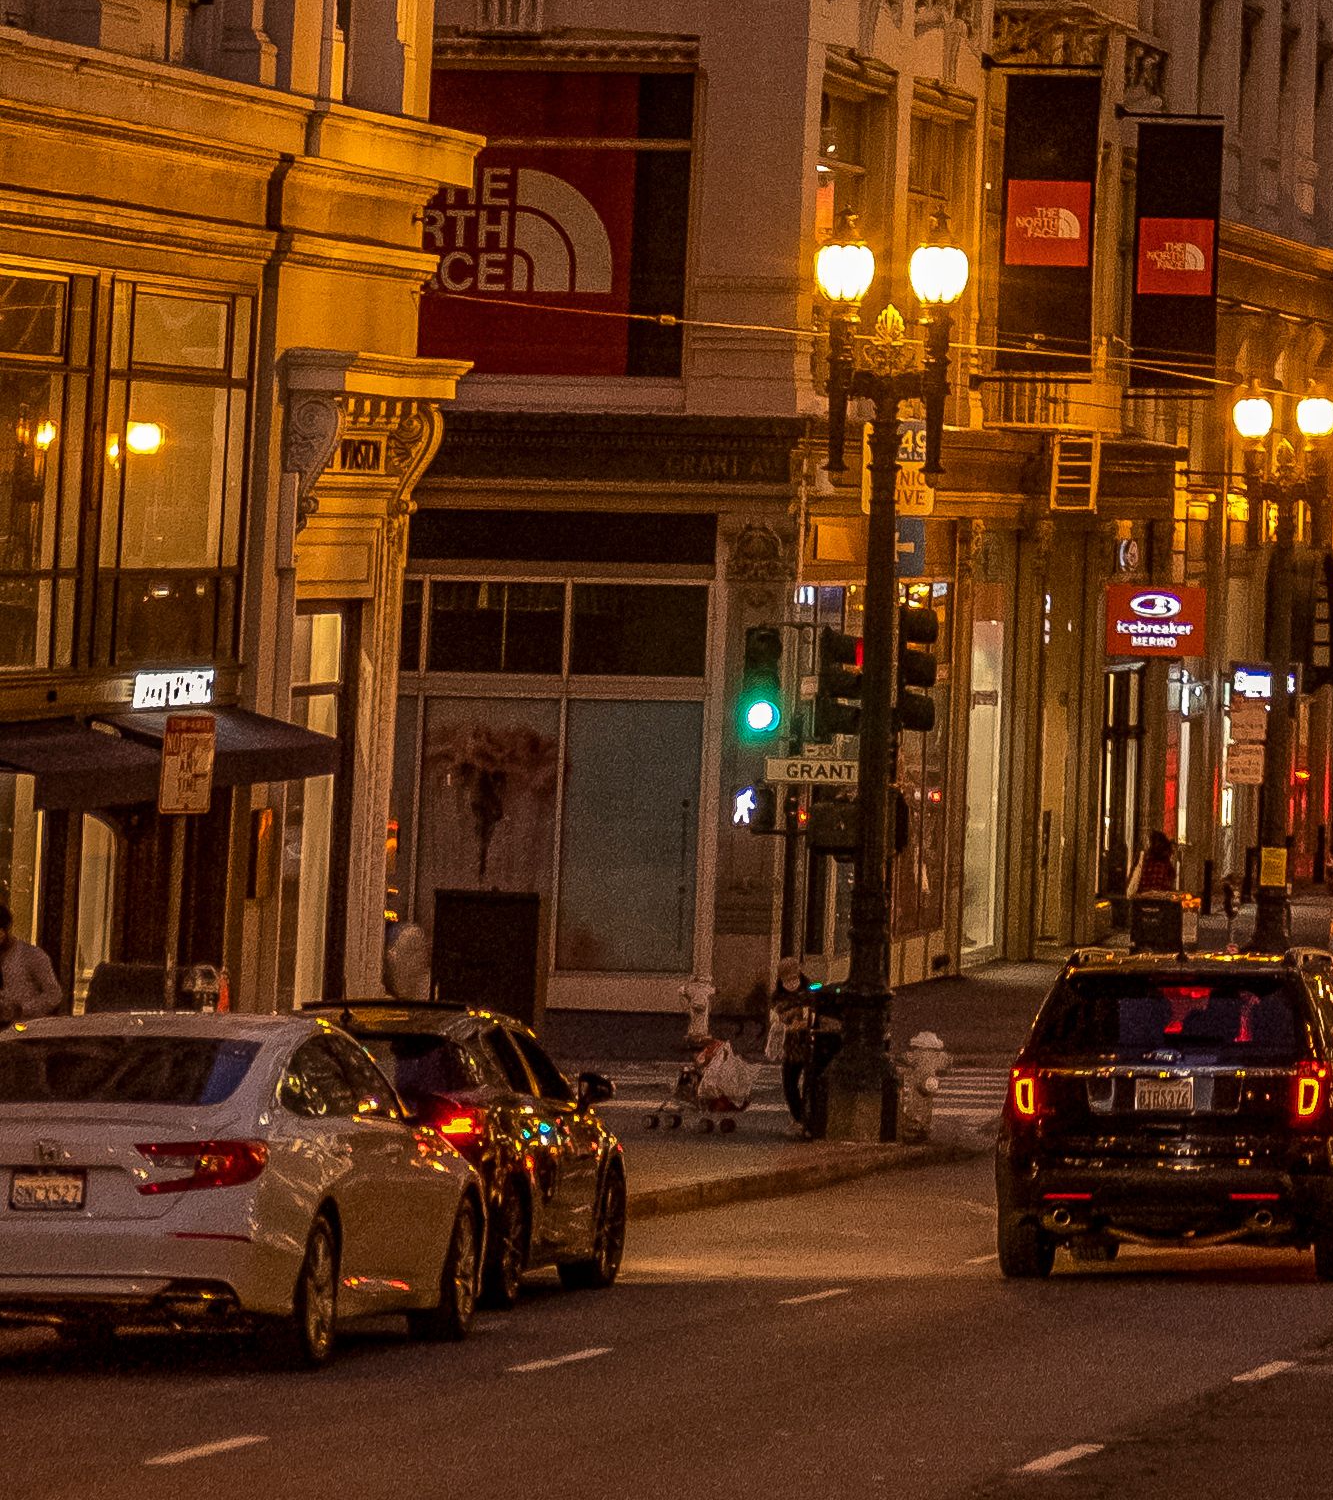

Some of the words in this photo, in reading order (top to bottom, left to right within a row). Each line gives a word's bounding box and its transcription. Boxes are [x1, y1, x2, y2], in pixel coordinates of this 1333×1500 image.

[1034, 207, 1059, 218] THE
[1015, 216, 1058, 228] NORTH
[1025, 227, 1059, 238] FACE
[1163, 242, 1187, 252] THE
[1146, 250, 1186, 261] NORTH
[1116, 620, 1194, 637] icebreaker
[1131, 636, 1177, 648] MERINO
[785, 762, 856, 779] GRANT
